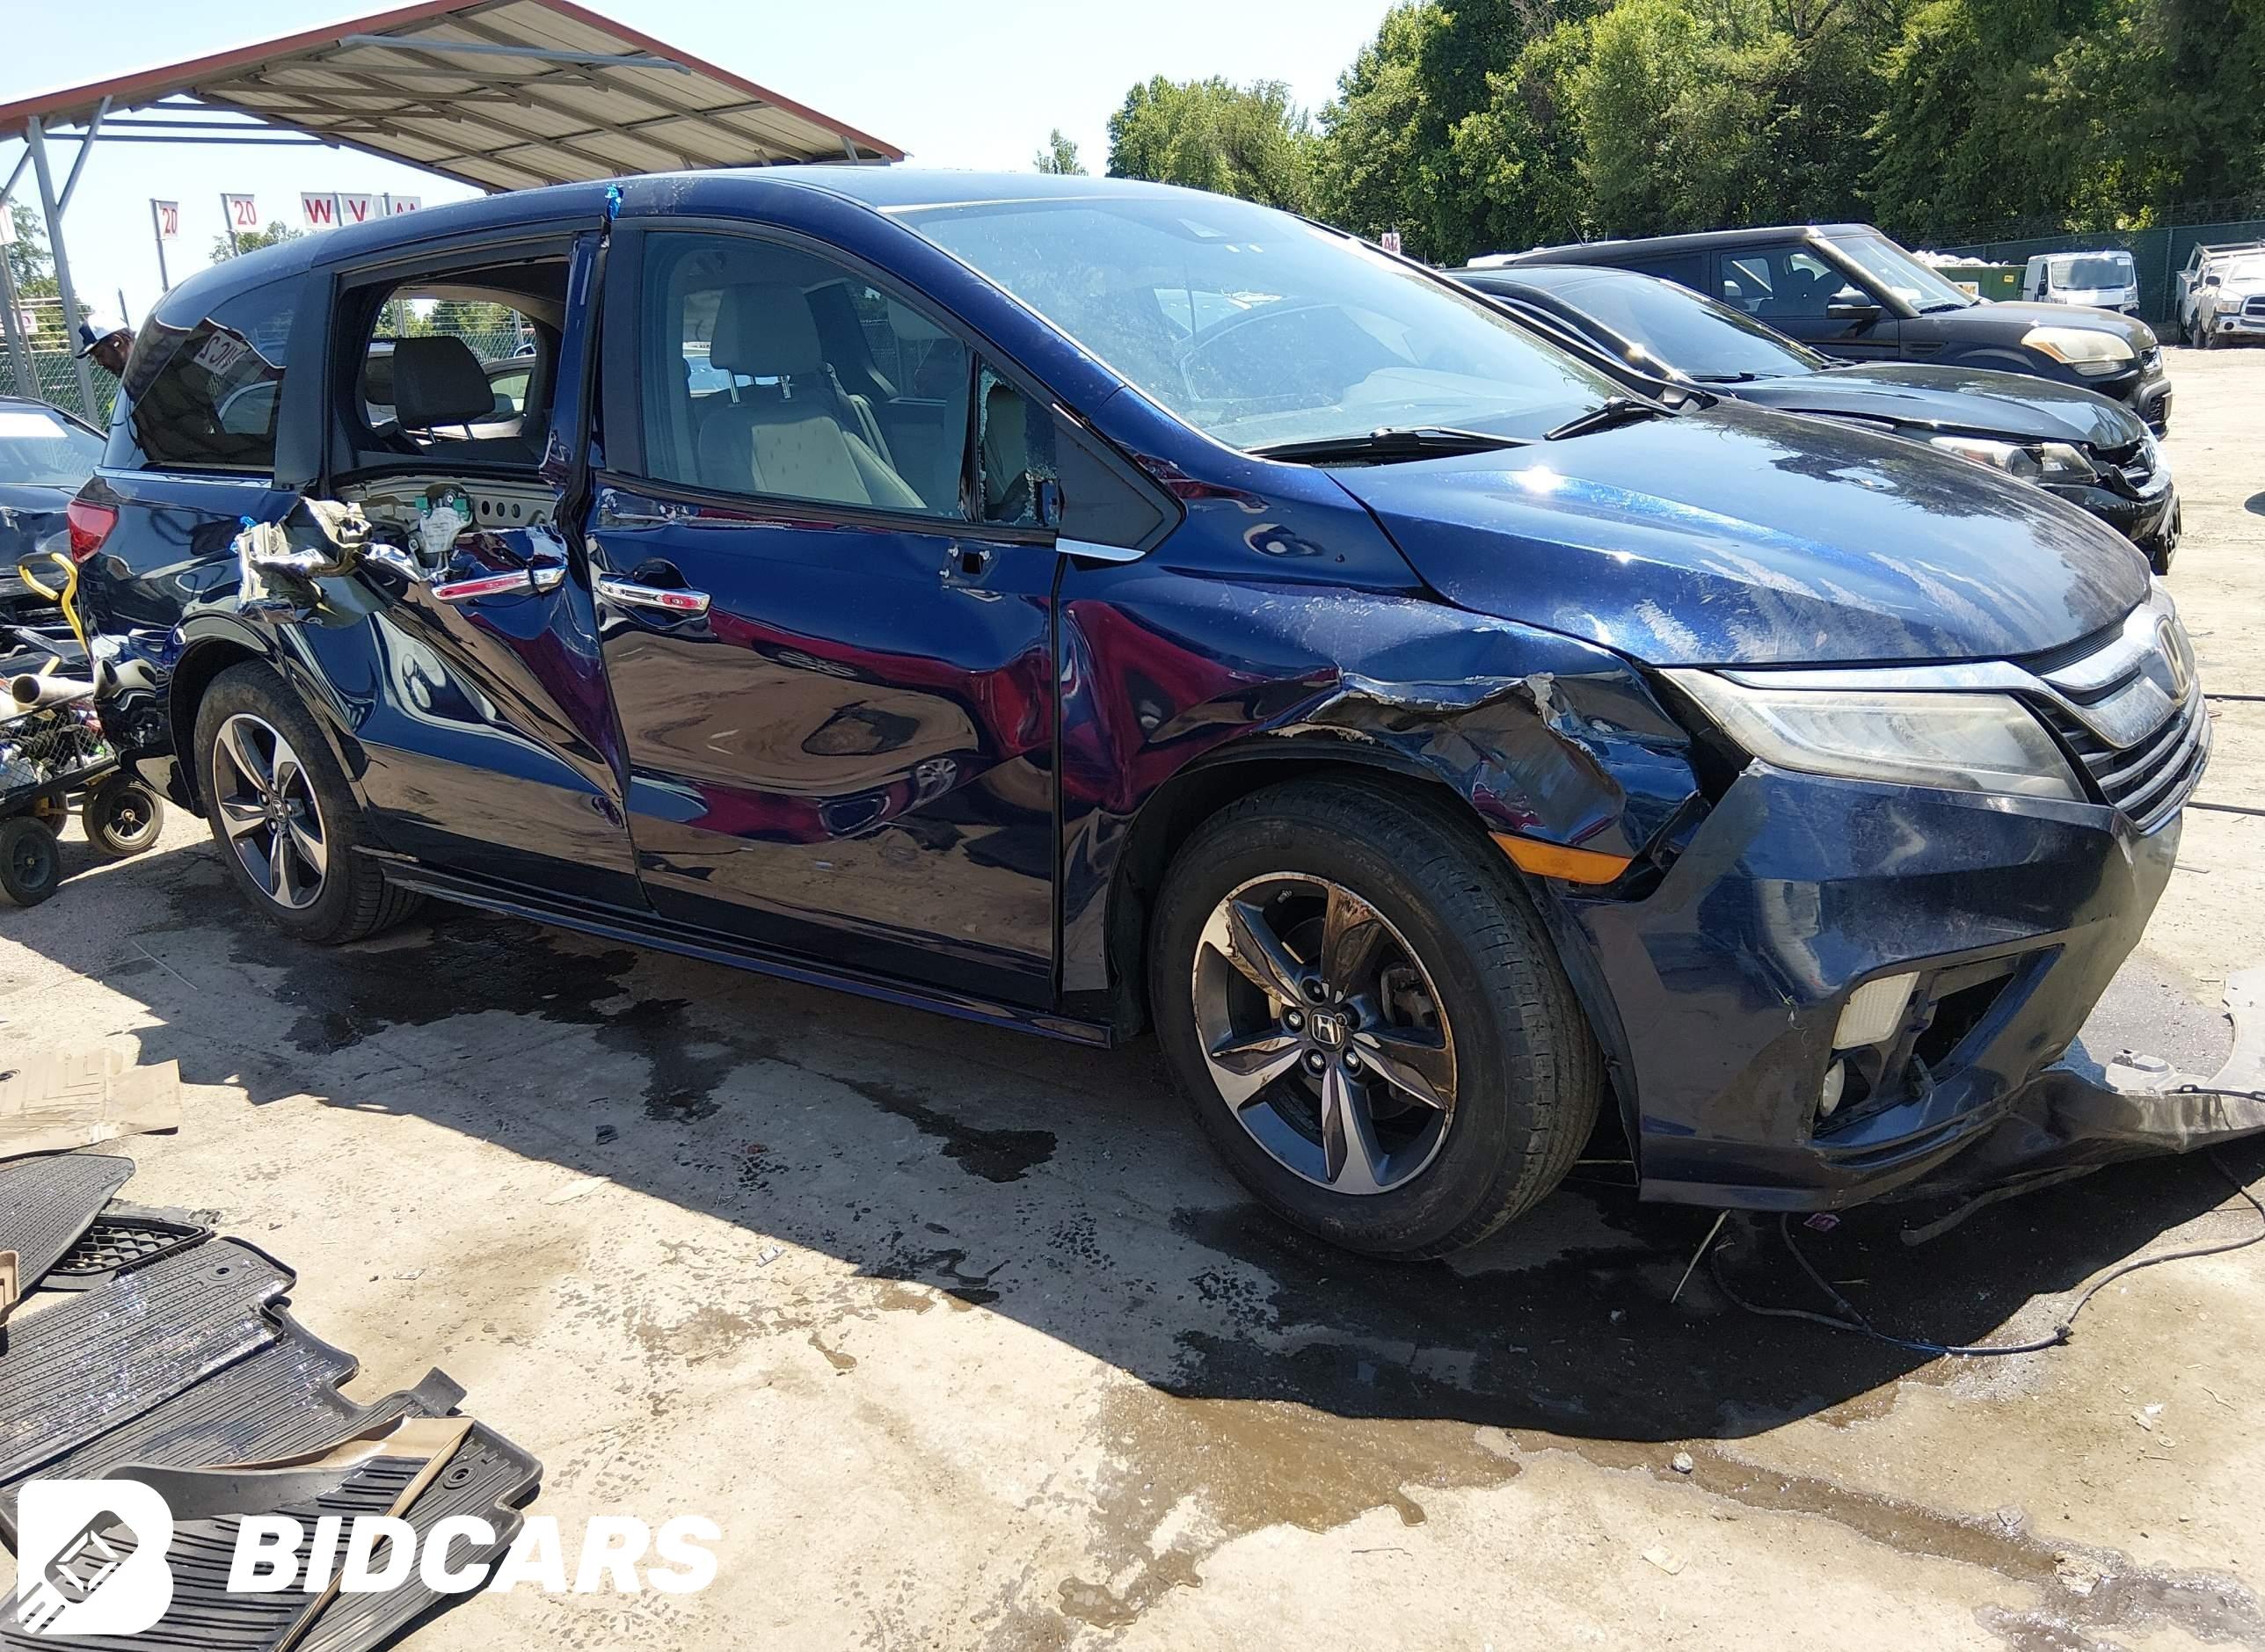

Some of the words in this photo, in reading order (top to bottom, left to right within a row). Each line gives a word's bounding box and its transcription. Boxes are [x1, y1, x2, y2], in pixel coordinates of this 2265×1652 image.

[162, 207, 178, 234] 20
[235, 200, 257, 225] 20
[305, 199, 331, 223] W
[348, 200, 367, 222] V
